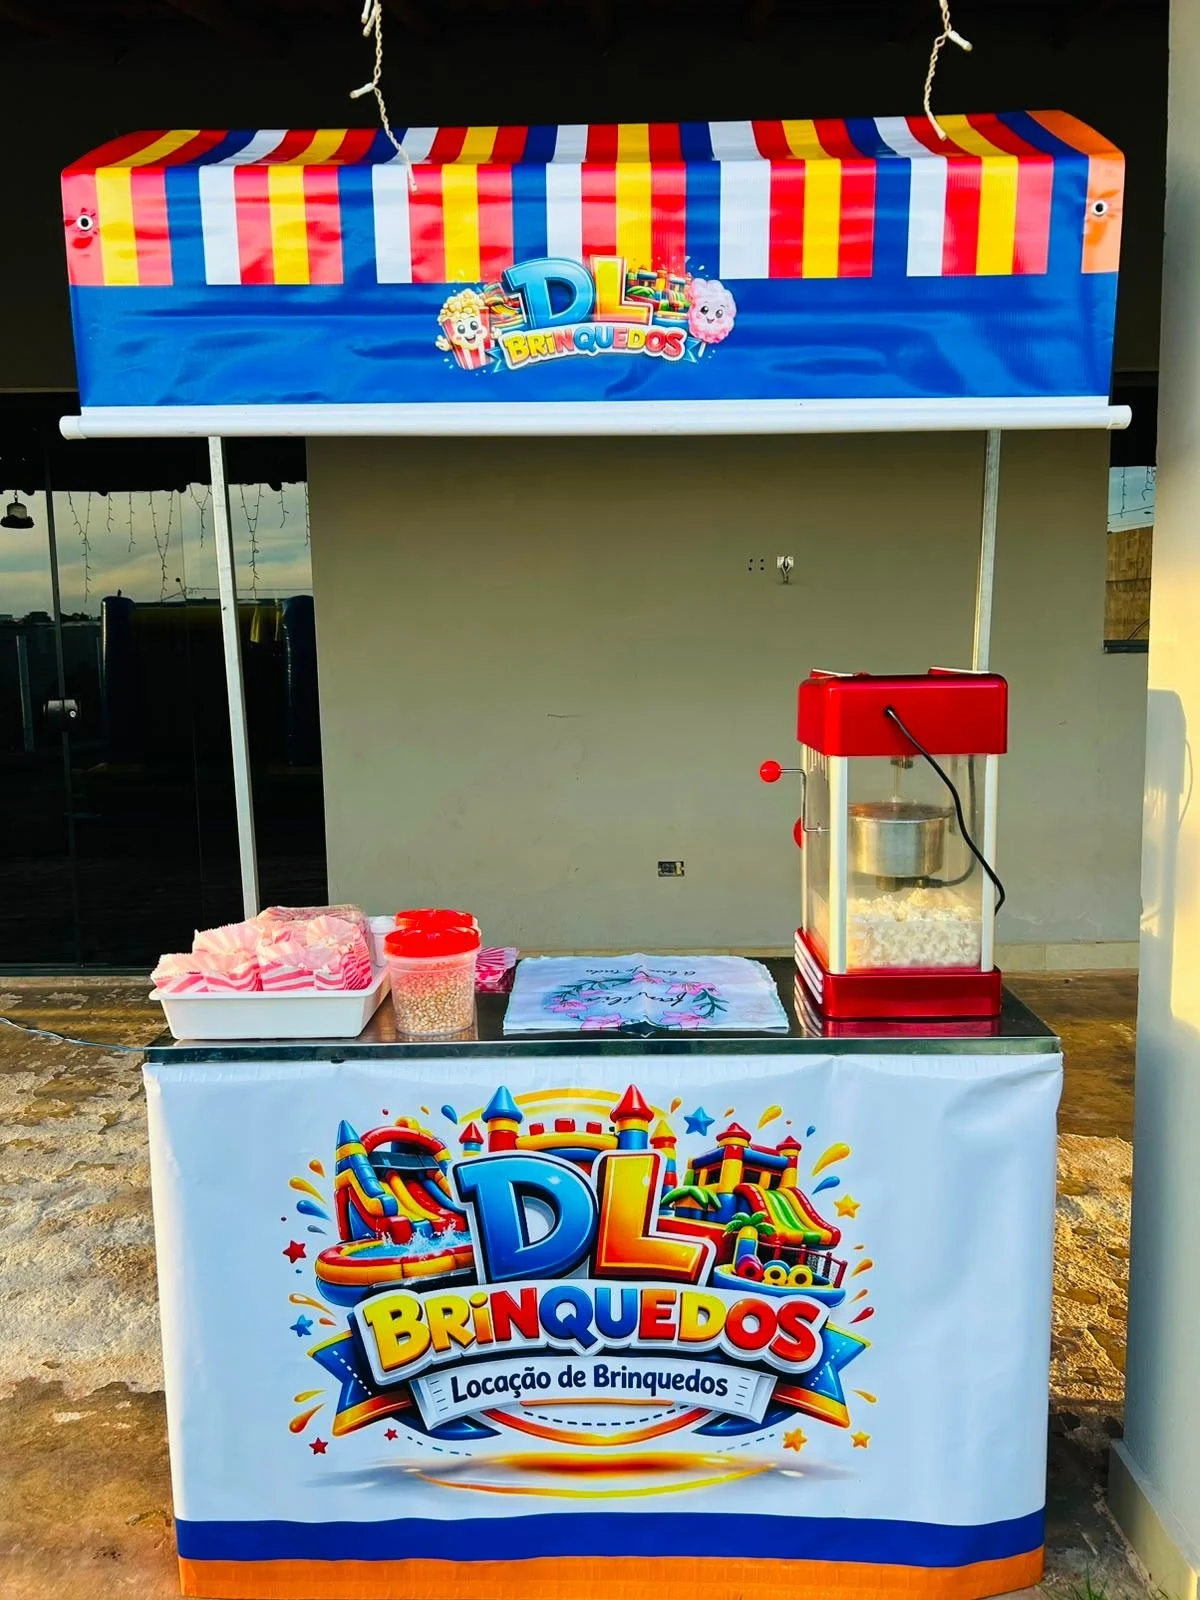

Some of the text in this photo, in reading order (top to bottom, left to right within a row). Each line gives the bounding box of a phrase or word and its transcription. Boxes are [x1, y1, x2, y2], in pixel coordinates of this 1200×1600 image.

[503, 256, 653, 328] DL
[458, 1152, 712, 1284] DL
[451, 1363, 729, 1404] Locação de Brinquedos
